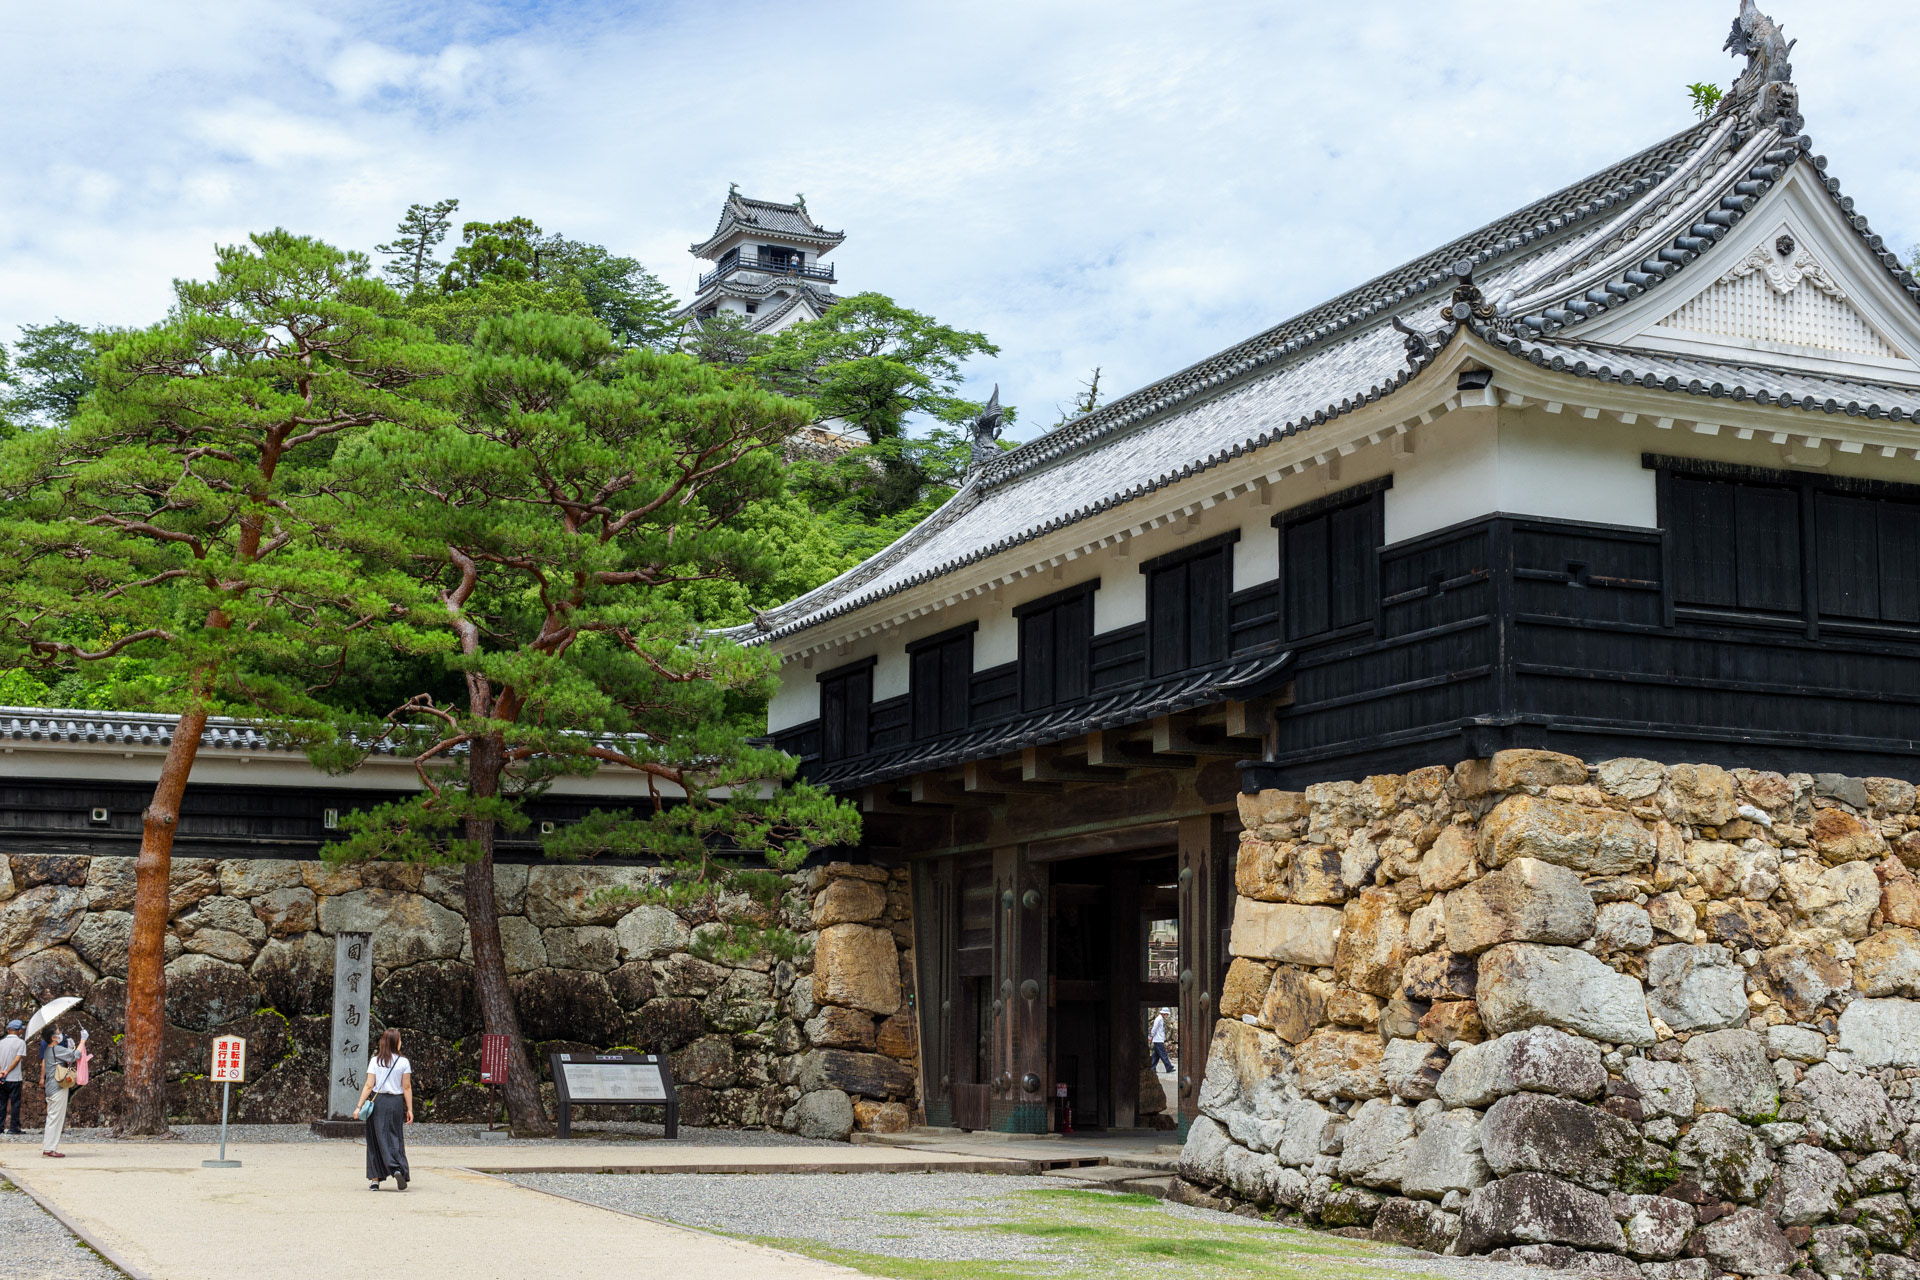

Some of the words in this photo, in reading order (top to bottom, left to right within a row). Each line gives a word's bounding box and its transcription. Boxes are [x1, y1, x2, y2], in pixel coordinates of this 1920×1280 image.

[217, 1041, 228, 1077] 通行禁止
[230, 1042, 240, 1068] 自転車
